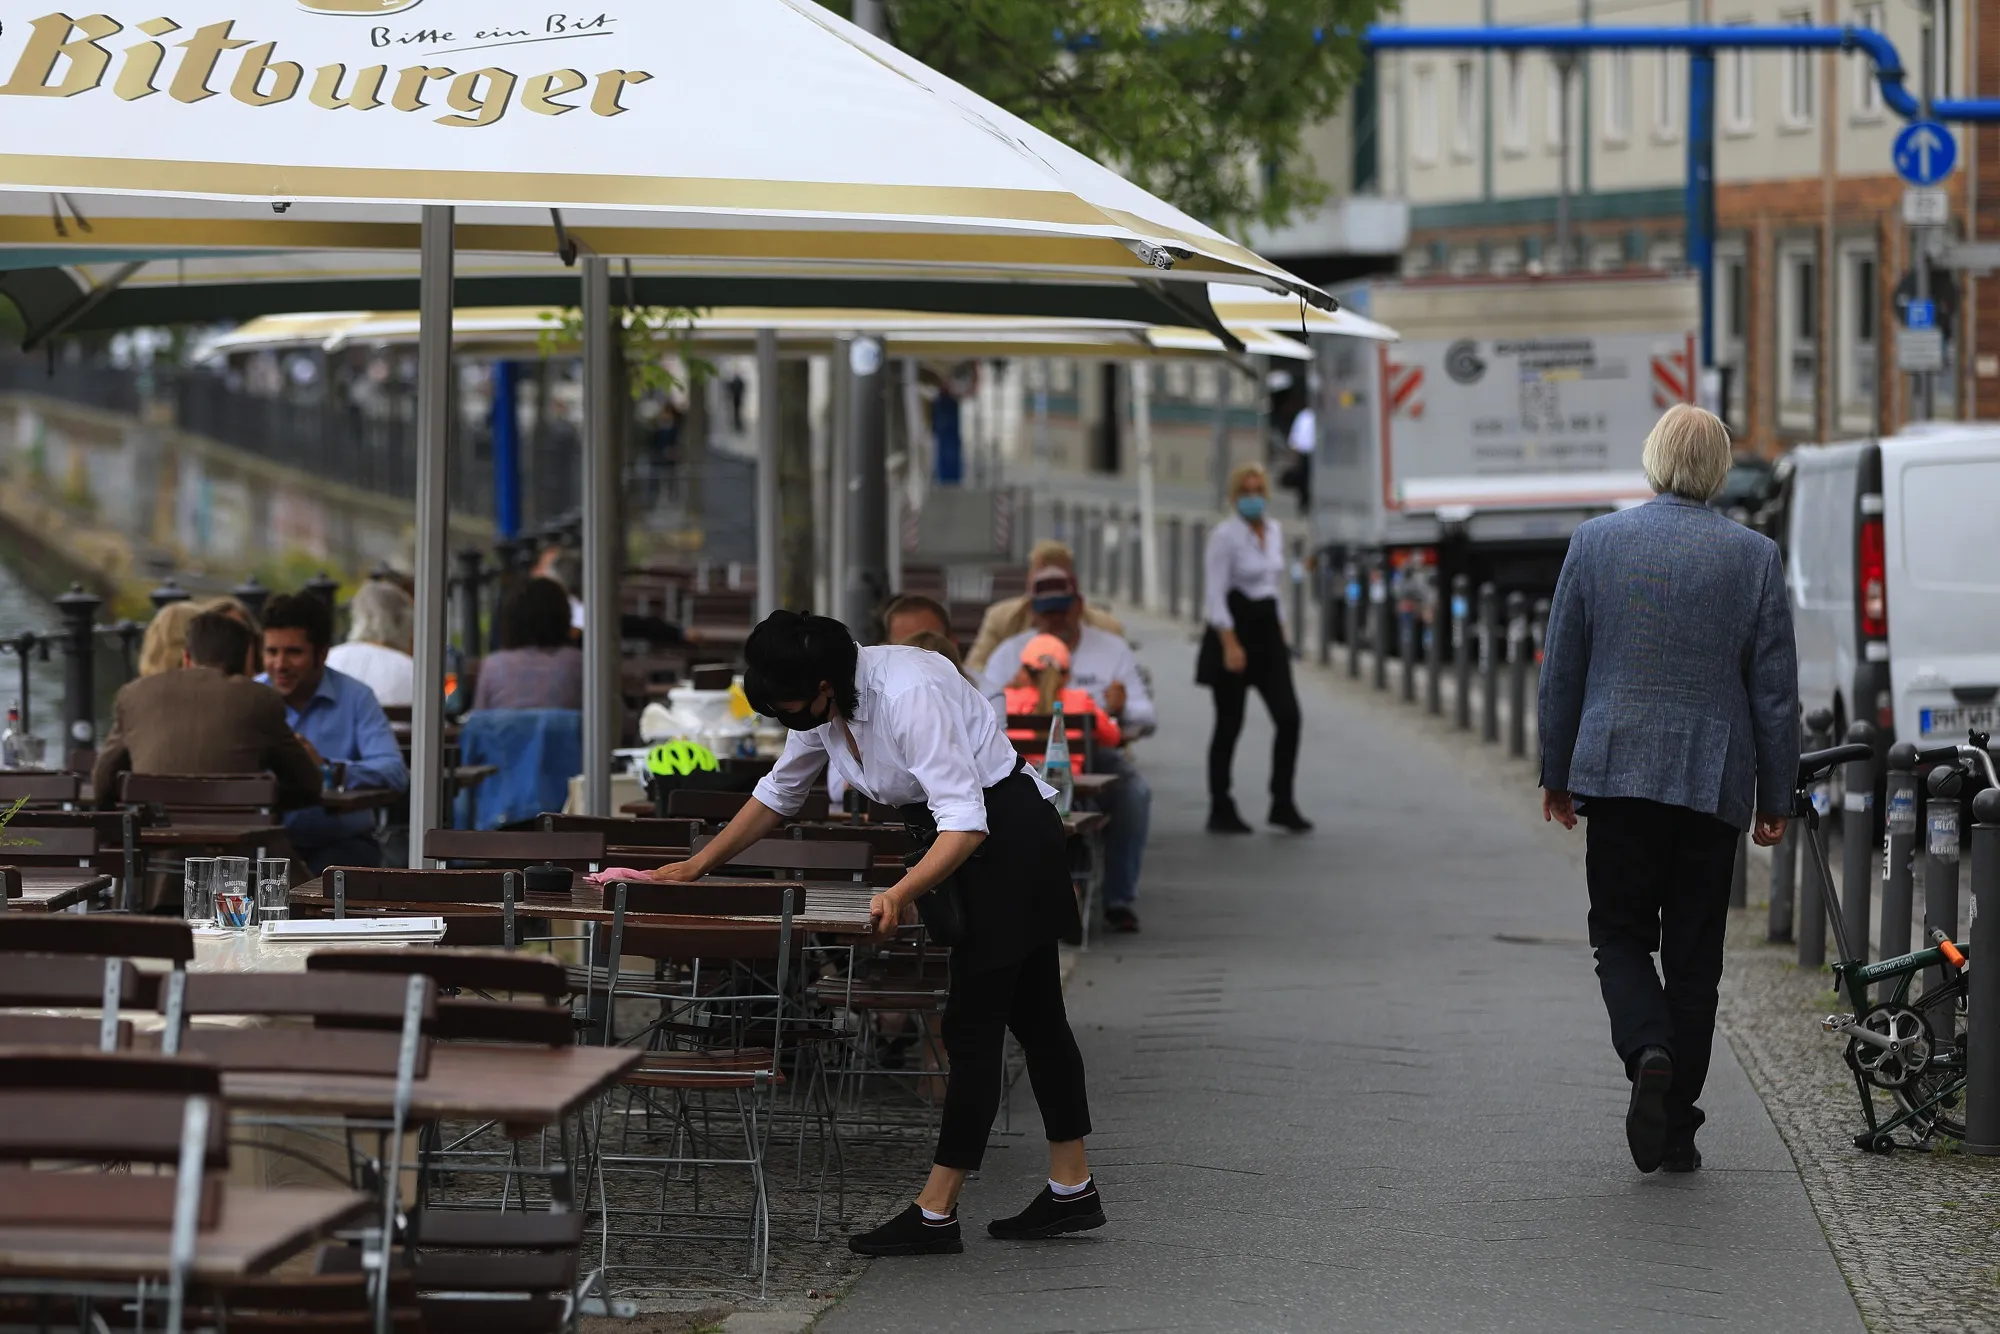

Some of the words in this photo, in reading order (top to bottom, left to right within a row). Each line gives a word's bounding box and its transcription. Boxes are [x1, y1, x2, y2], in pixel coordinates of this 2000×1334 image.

[370, 26, 456, 48] Bitte
[474, 27, 530, 40] ein
[545, 13, 618, 33] Bit
[0, 12, 655, 128] Bitburger
[1869, 957, 1913, 975] BROMPTON
